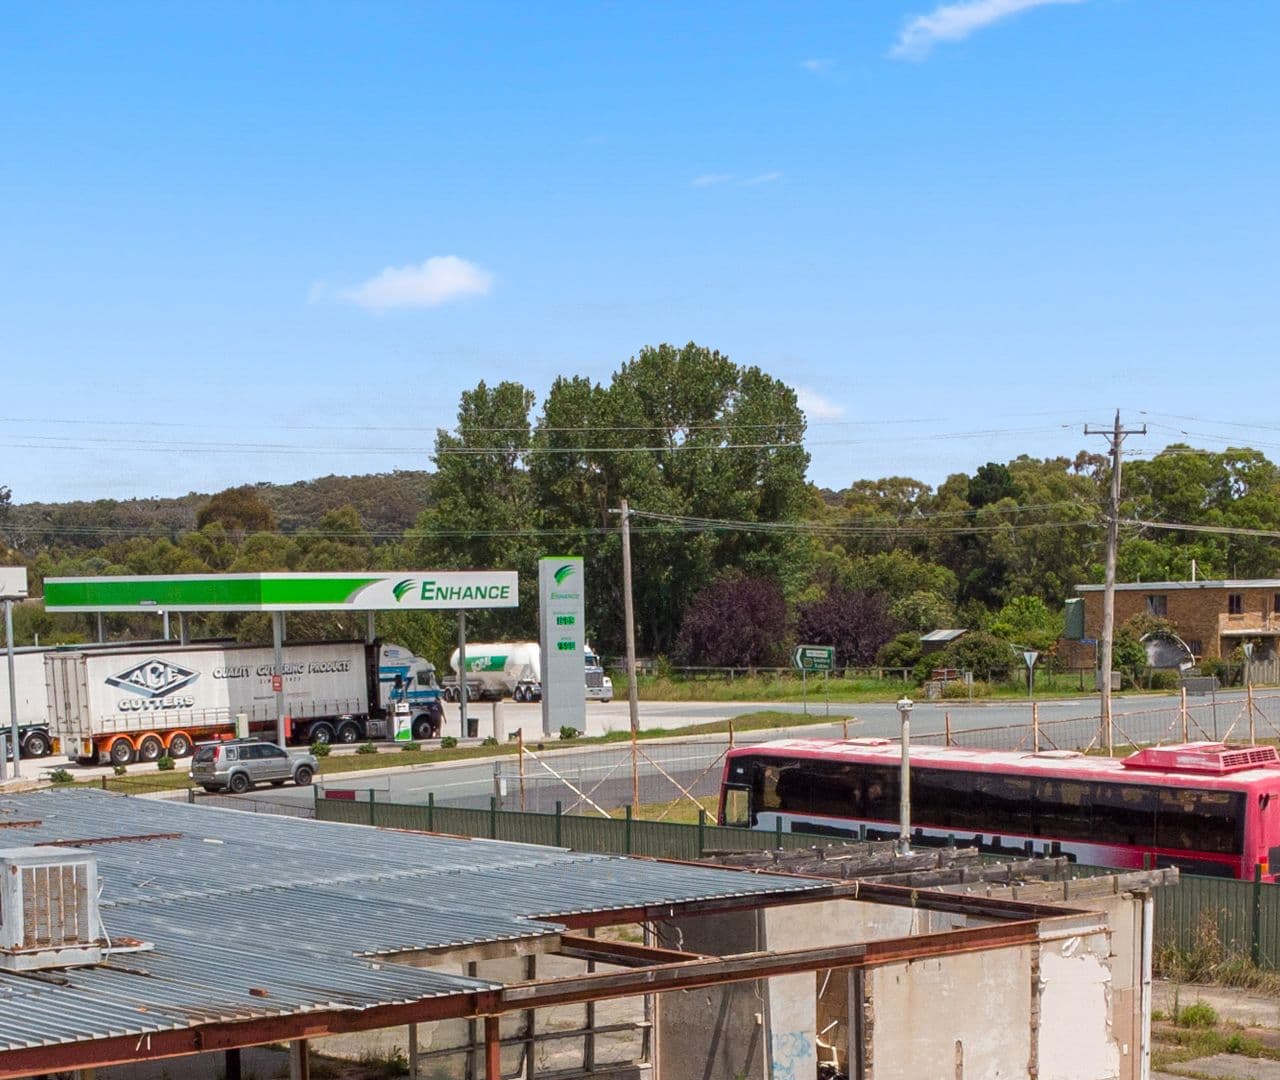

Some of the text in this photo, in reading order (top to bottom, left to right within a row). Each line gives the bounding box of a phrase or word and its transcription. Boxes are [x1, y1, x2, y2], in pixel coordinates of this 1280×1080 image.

[421, 581, 510, 600] ENHANCE
[129, 661, 186, 690] ACE
[213, 665, 253, 679] QUALITY
[308, 660, 352, 674] PRODUCTS
[118, 695, 195, 712] GUTTERS
